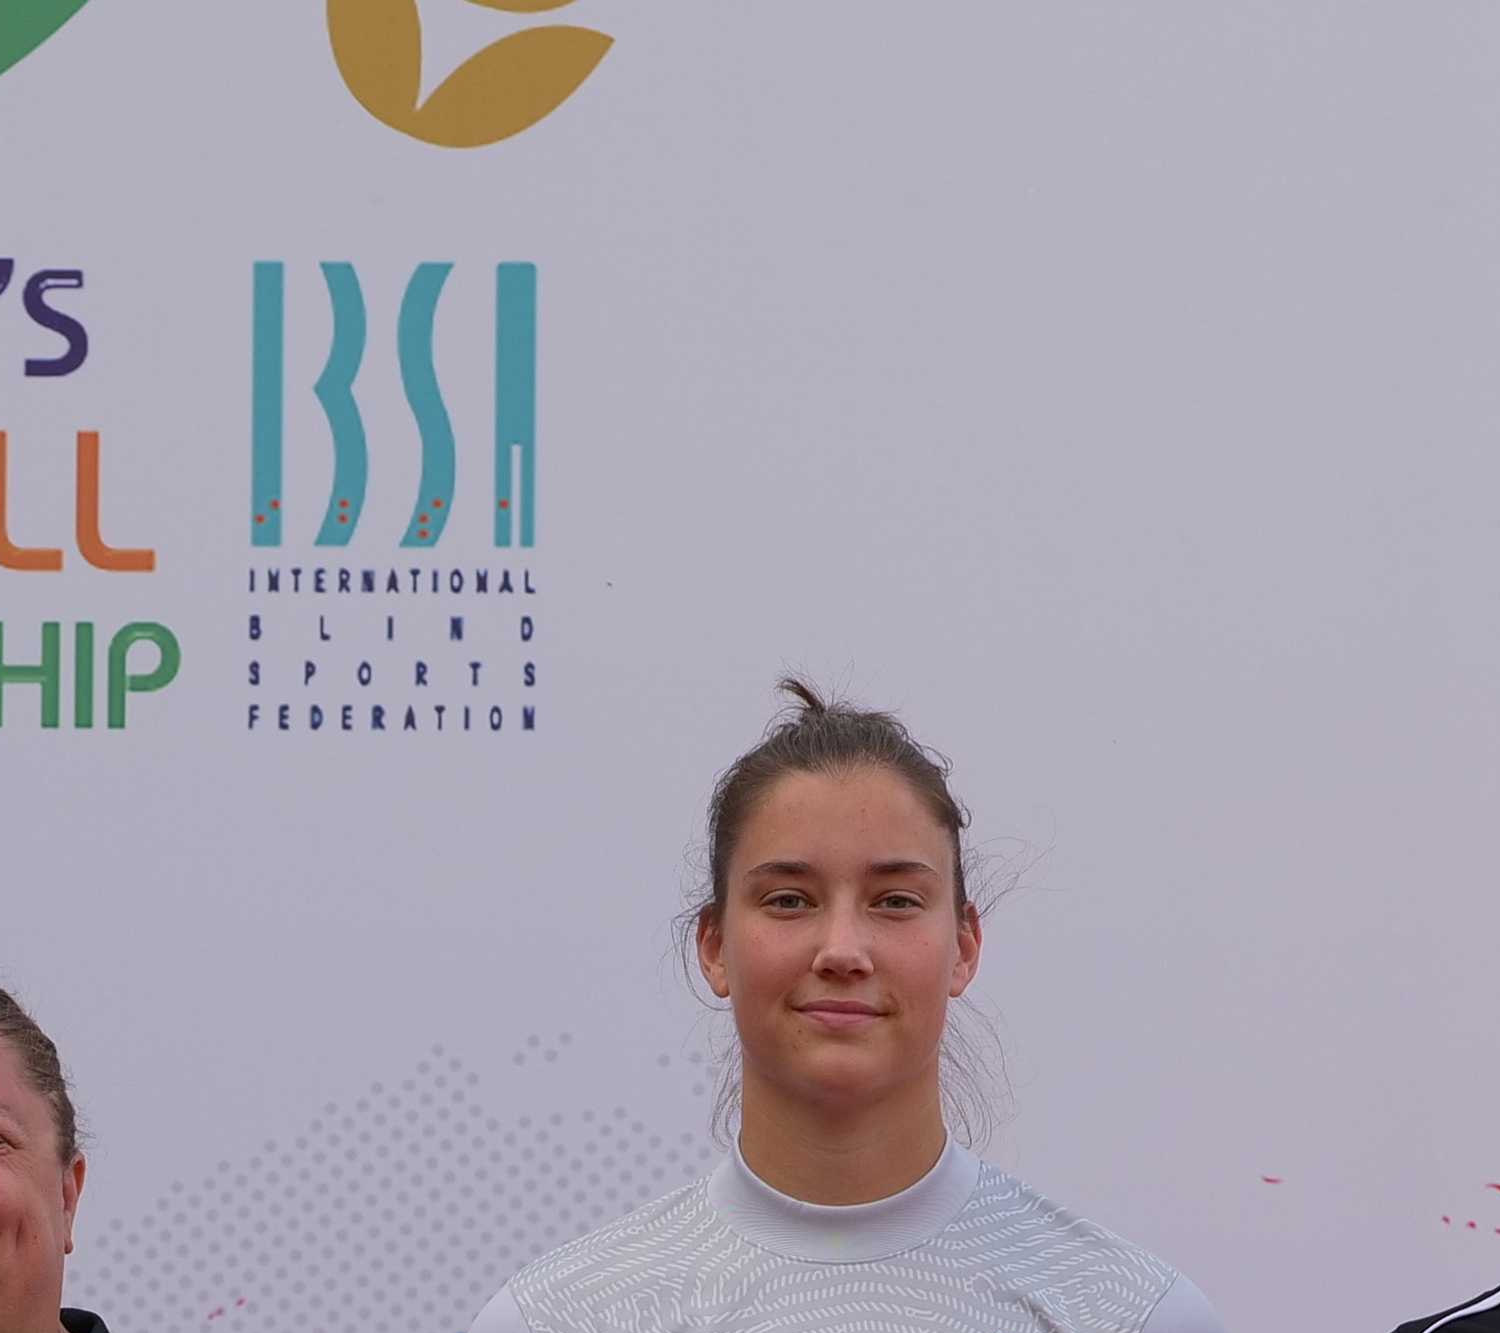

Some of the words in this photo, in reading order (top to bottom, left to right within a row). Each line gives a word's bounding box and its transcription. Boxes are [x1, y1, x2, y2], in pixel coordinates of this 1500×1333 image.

[248, 566, 536, 595] INTERNATIONAL
[248, 613, 534, 642] BLIND
[248, 659, 536, 688] SPORTS
[248, 703, 535, 732] FEDERATION
